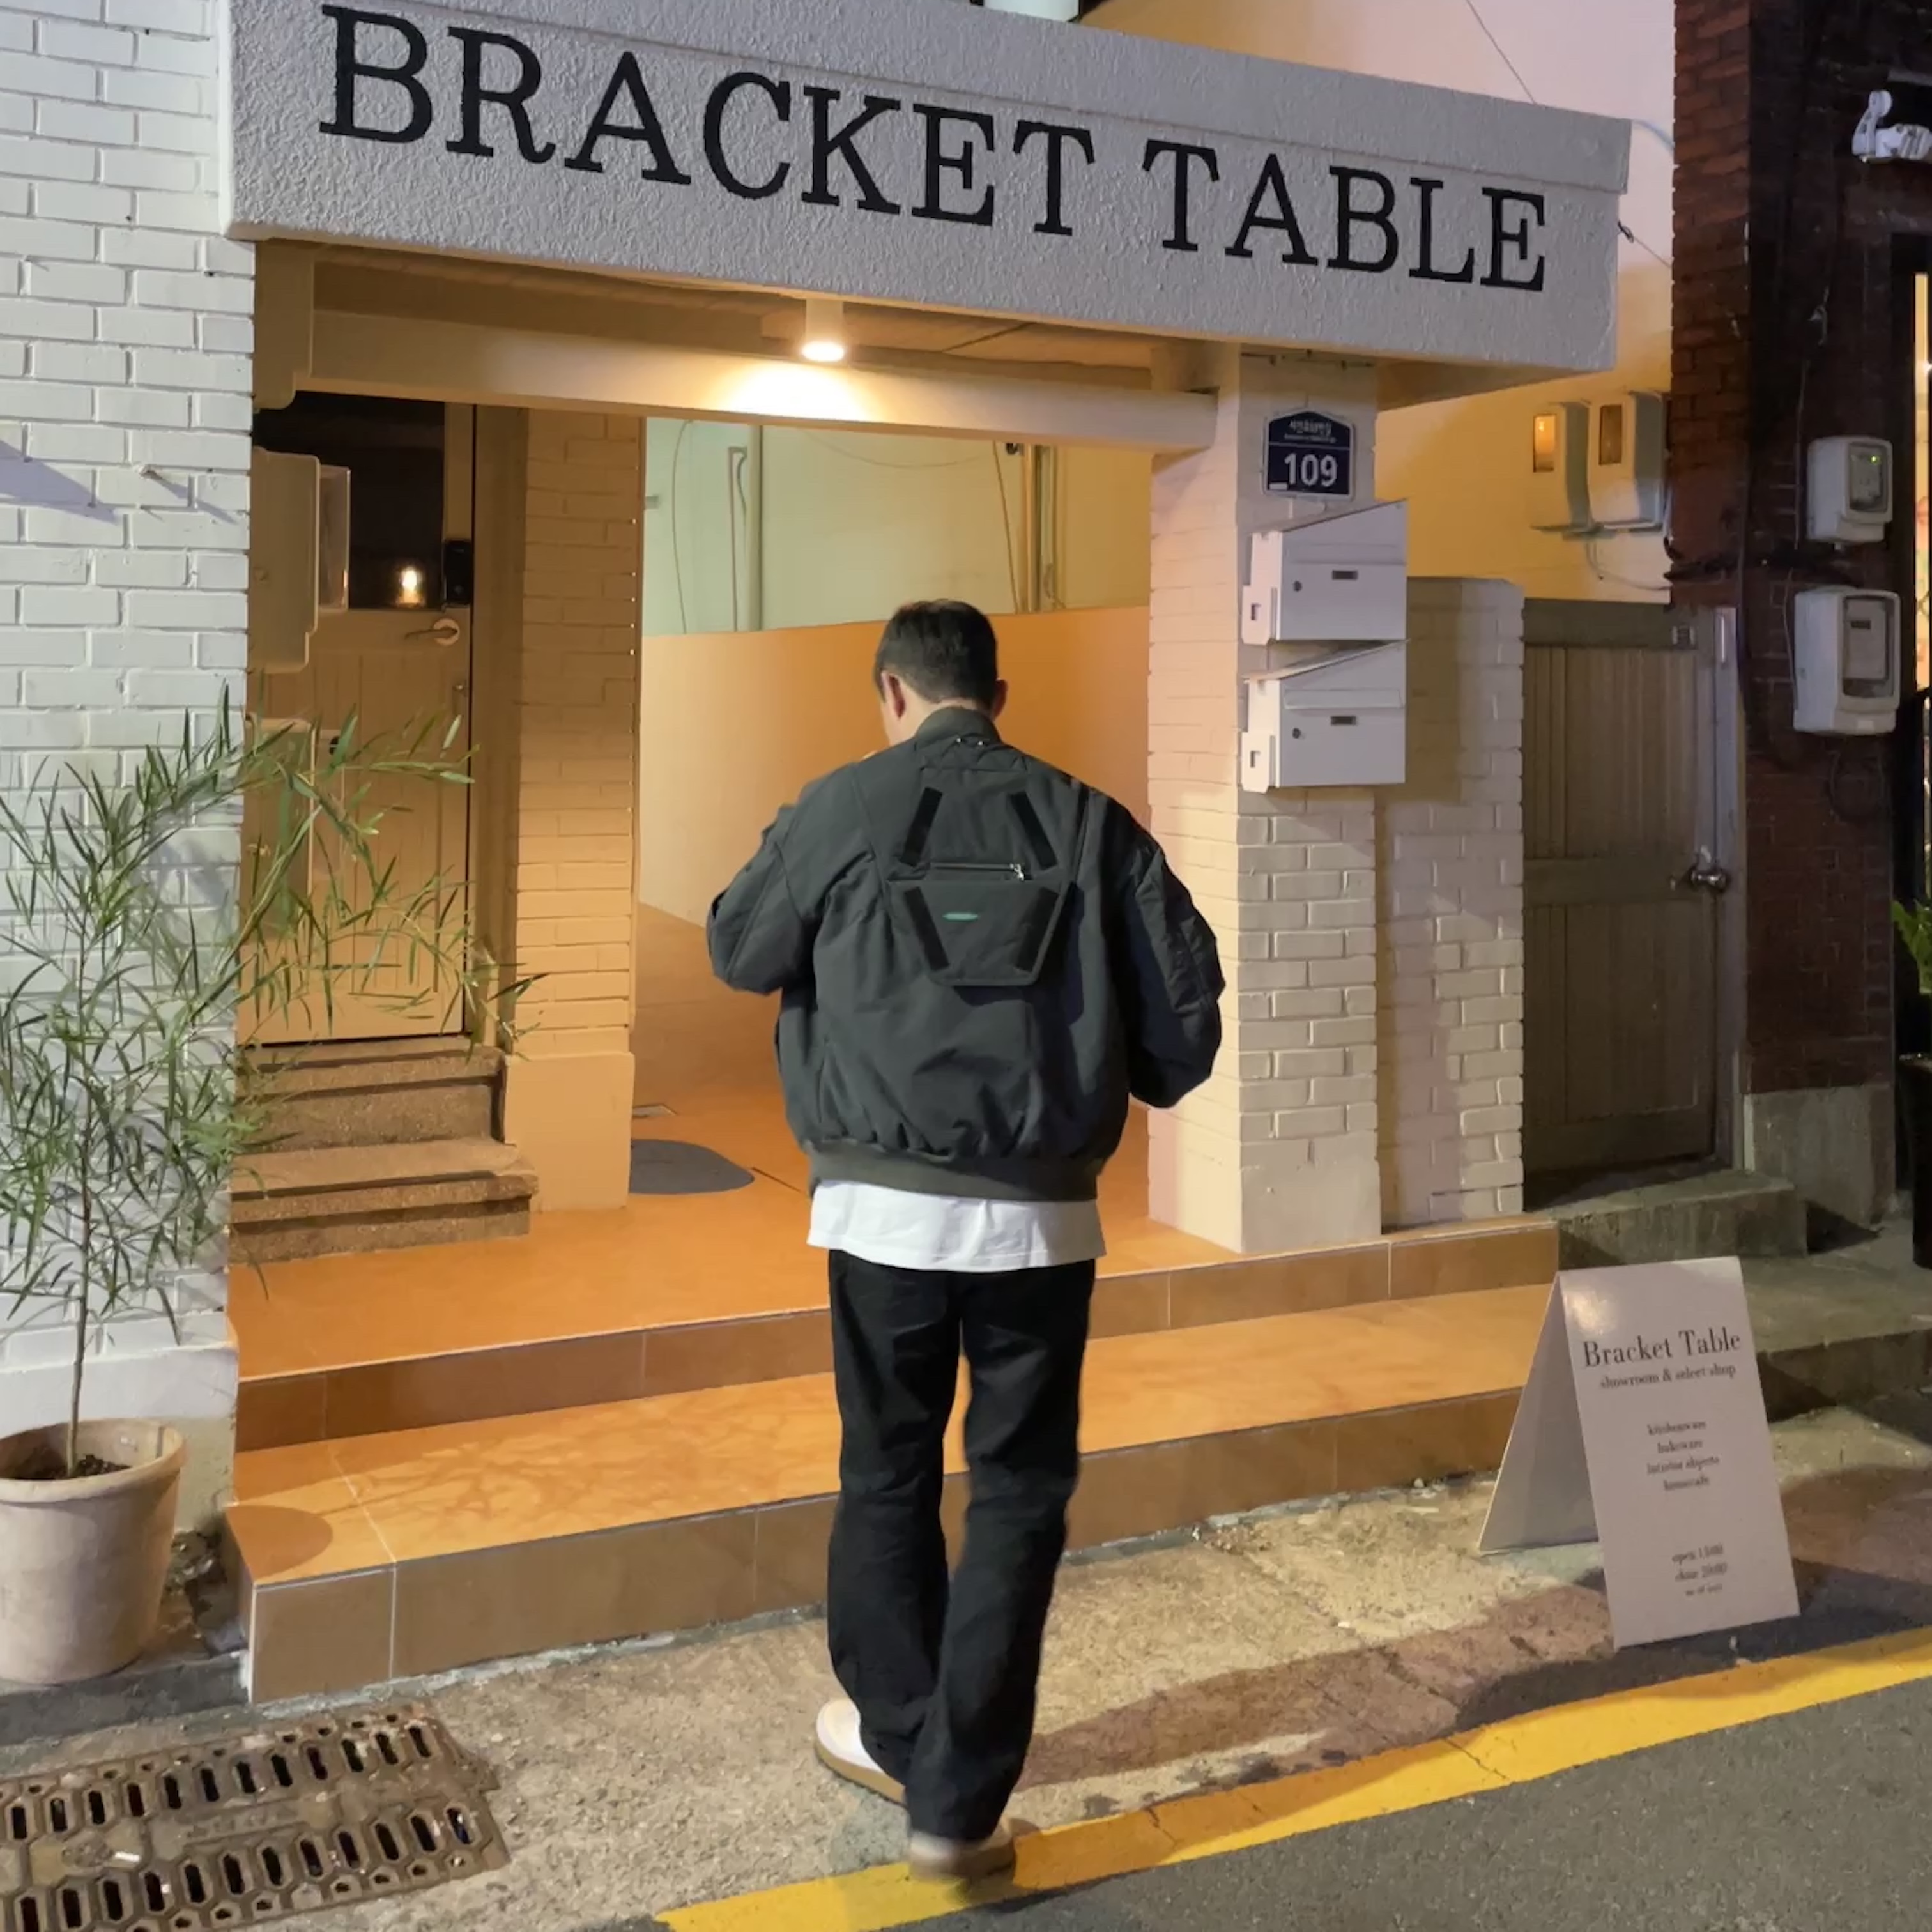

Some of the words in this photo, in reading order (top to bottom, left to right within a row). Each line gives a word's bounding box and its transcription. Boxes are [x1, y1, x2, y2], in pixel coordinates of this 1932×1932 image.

[319, 5, 1094, 236] BRACKET
[1142, 139, 1545, 291] TABLE
[1284, 453, 1338, 486] 109
[1584, 1335, 1673, 1367] Bracket
[1678, 1326, 1740, 1356] Table
[1600, 1374, 1659, 1389] showroom
[1663, 1368, 1672, 1382] &
